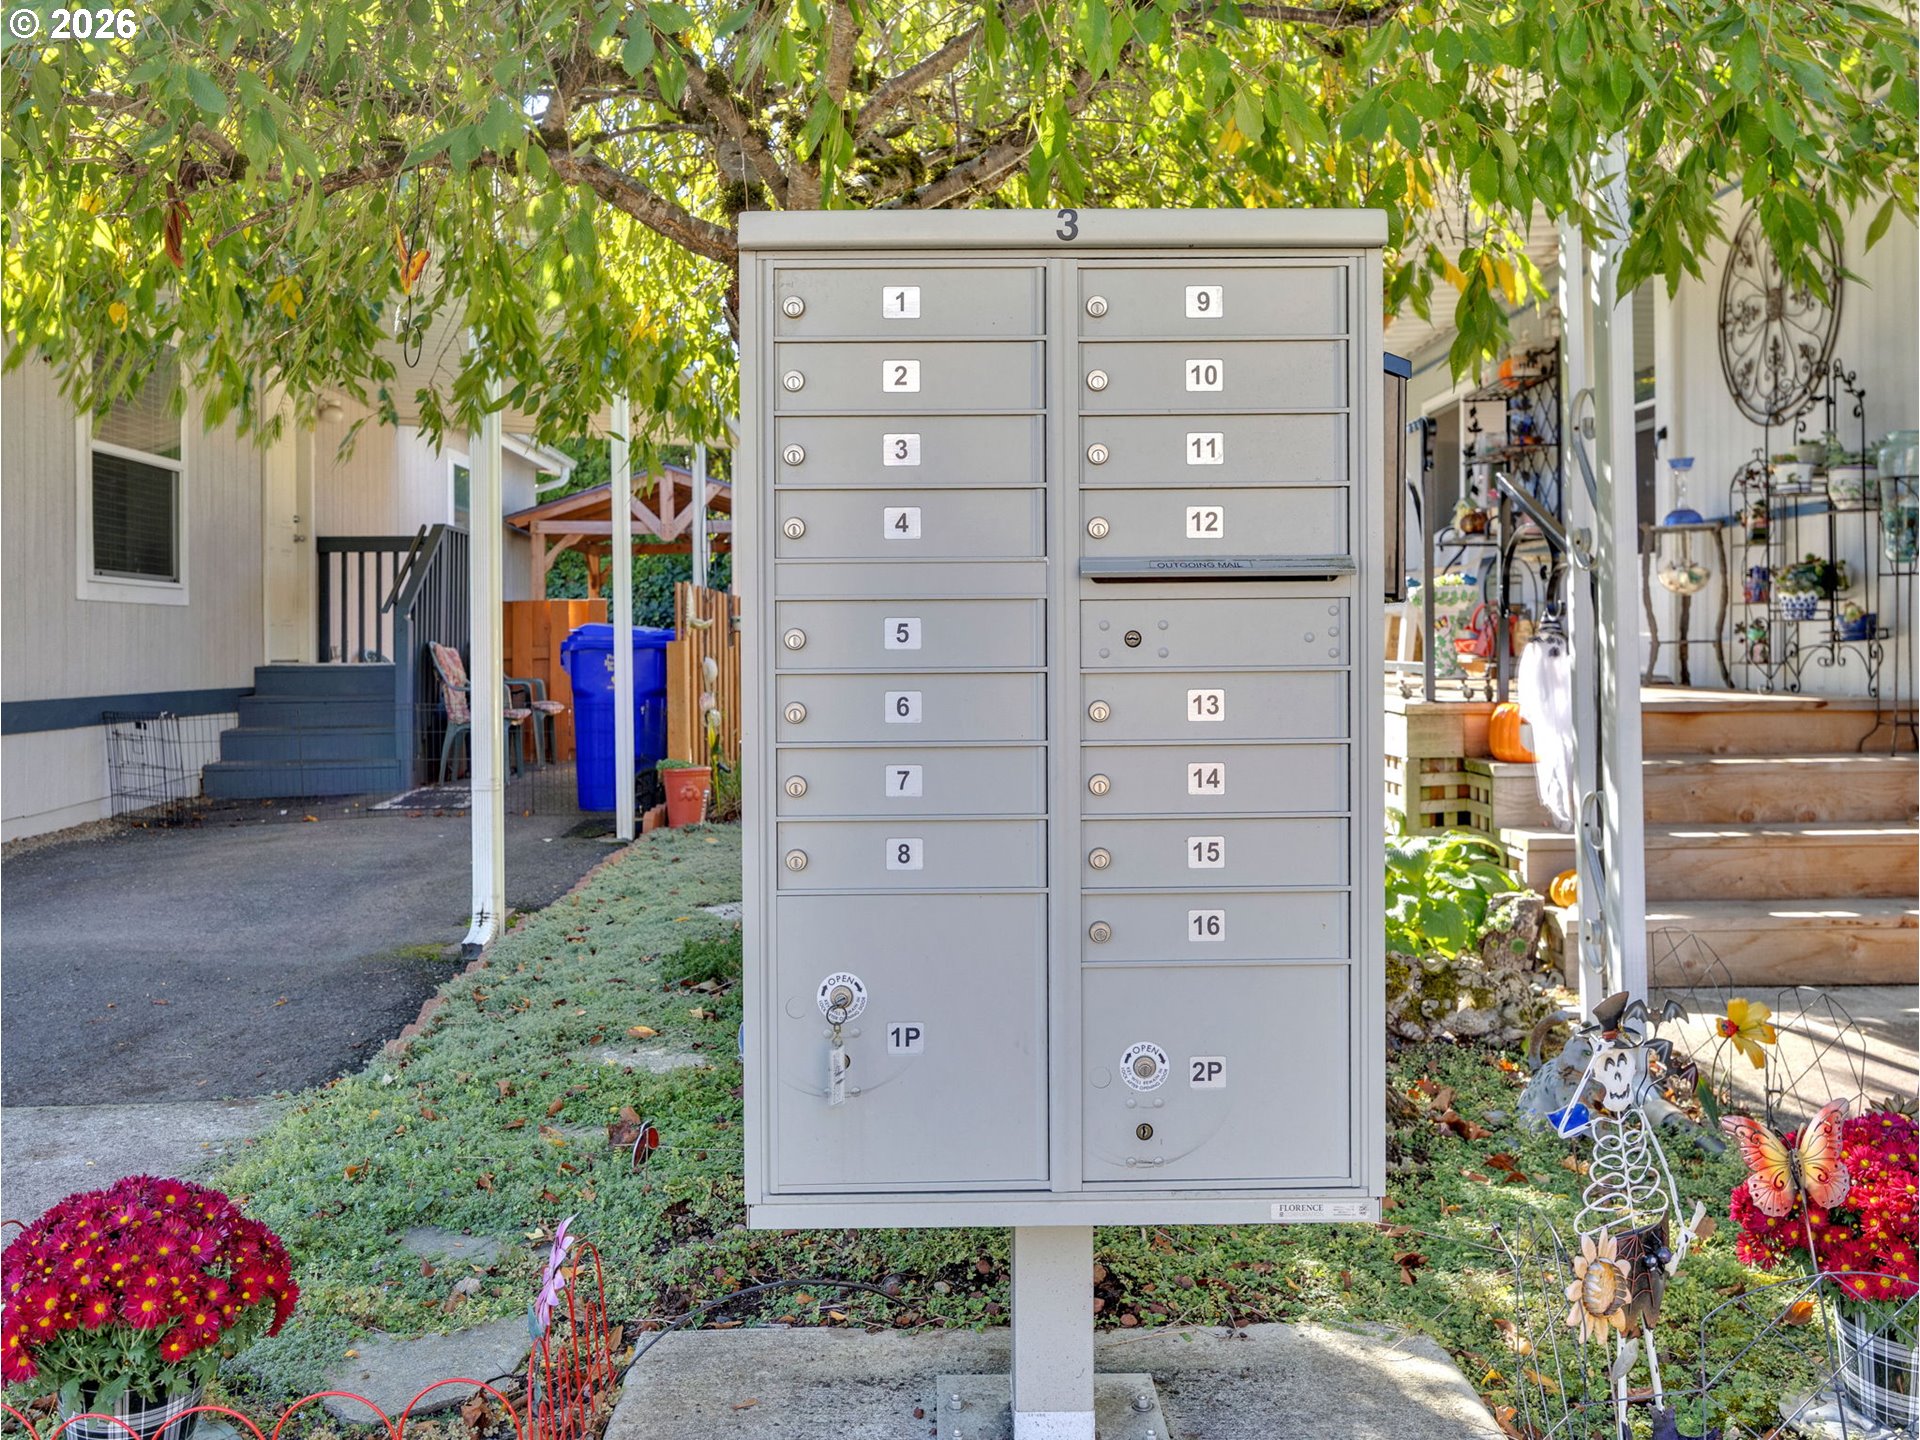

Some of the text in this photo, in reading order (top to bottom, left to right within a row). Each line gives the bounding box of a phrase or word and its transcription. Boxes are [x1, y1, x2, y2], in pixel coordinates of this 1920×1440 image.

[1056, 208, 1079, 241] 3
[895, 292, 905, 312] 1
[1197, 291, 1210, 311] 9
[894, 366, 908, 386] 2
[1191, 365, 1217, 385] 10
[895, 439, 908, 459] 3
[1191, 438, 1216, 458] 11
[894, 512, 909, 533] 4
[1191, 511, 1218, 532] 12
[896, 623, 910, 643] 5
[896, 696, 910, 717] 6
[1193, 695, 1219, 715] 13
[896, 770, 910, 791] 7
[1193, 768, 1220, 788] 14
[897, 843, 911, 864] 8
[1193, 842, 1220, 862] 15
[1193, 915, 1220, 936] 16
[828, 974, 855, 986] OPEN
[890, 1027, 921, 1048] 1P
[1132, 1044, 1160, 1055] OPEN
[1192, 1061, 1223, 1082] 2P
[1279, 1204, 1324, 1212] FLORENCE
